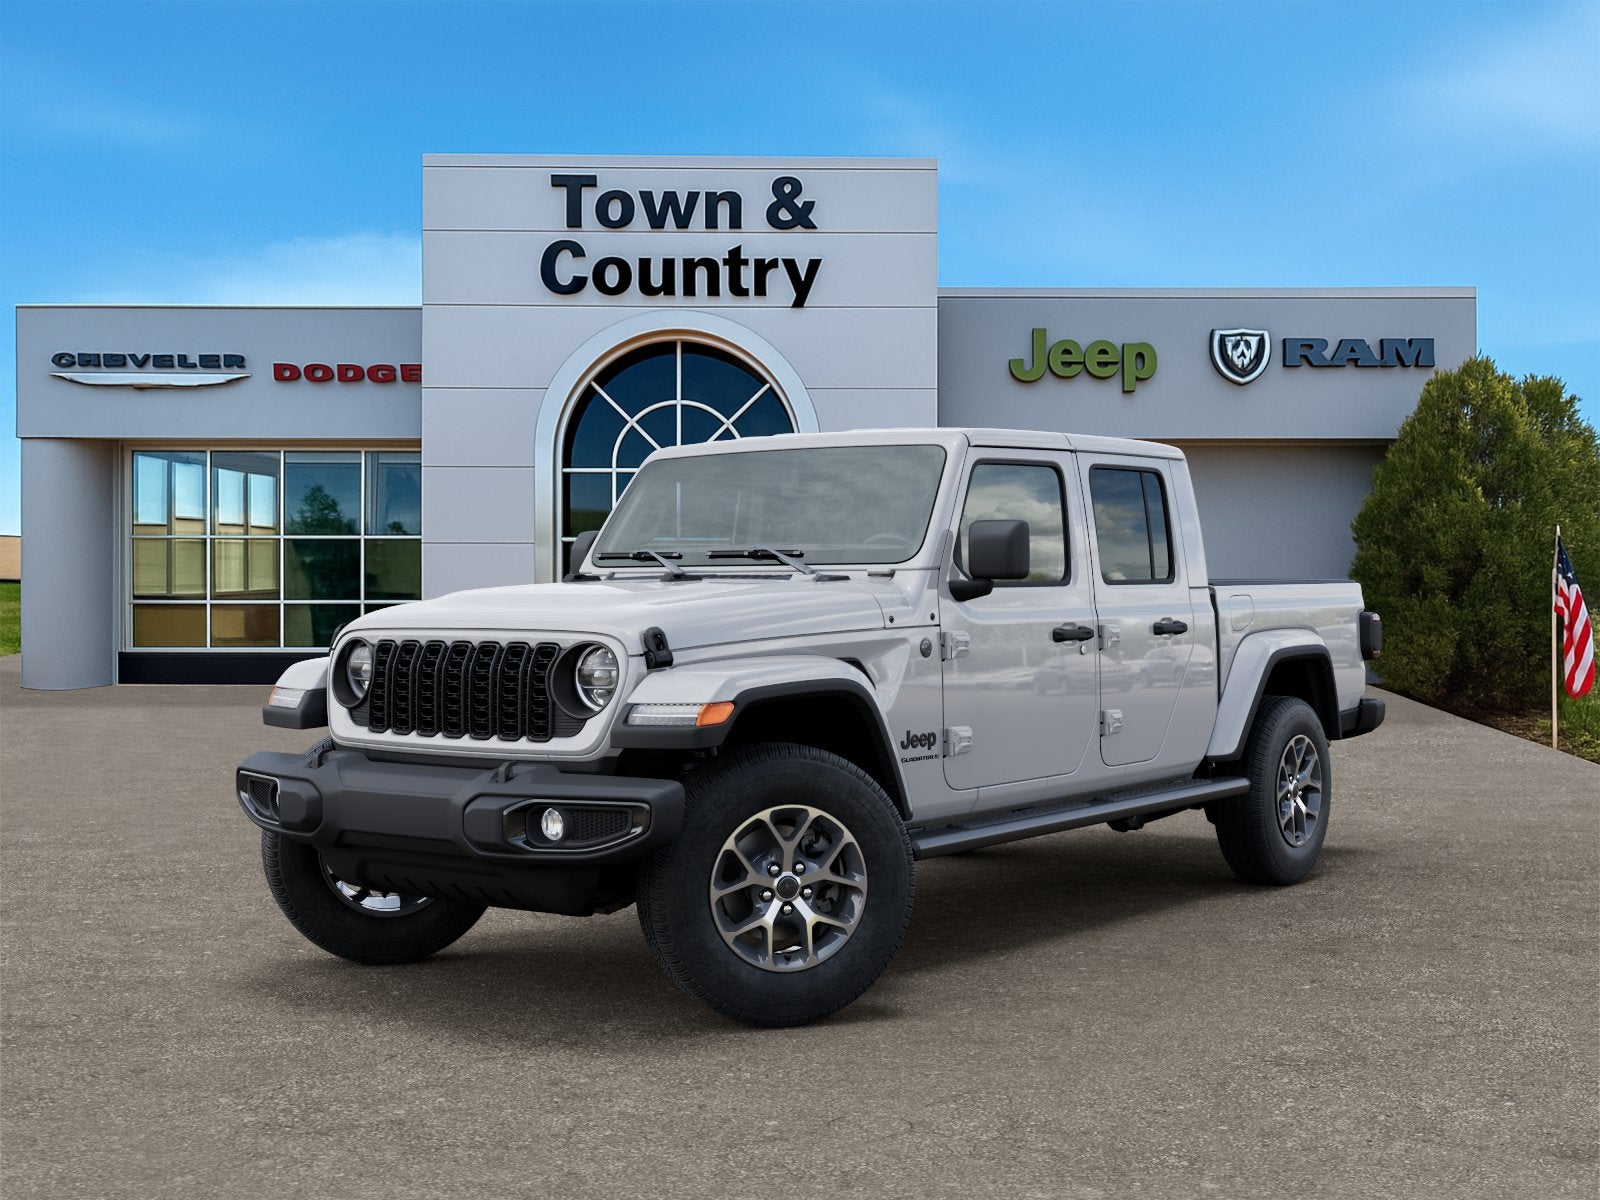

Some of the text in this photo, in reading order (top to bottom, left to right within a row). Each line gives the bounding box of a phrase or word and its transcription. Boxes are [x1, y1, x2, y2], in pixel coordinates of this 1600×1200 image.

[550, 174, 818, 230] Town &
[540, 239, 823, 308] Country
[273, 363, 422, 383] DODGE
[1008, 327, 1158, 393] Jeep
[1282, 337, 1436, 367] RAM
[900, 729, 937, 751] Jeep
